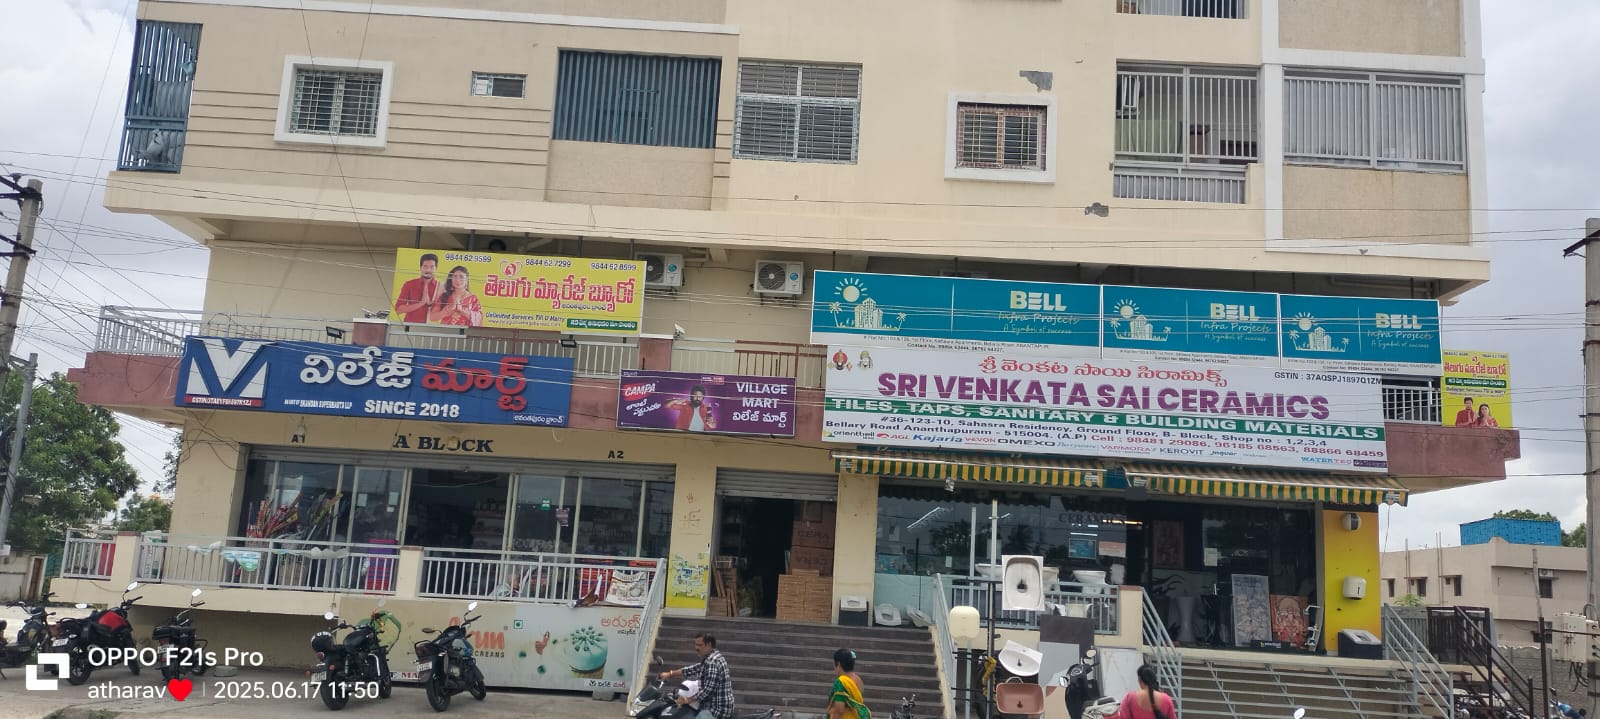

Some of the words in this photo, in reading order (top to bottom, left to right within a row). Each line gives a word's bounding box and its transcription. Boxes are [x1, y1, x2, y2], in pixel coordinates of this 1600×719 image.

[445, 253, 462, 261] 9844
[554, 260, 571, 268] 7299
[484, 274, 531, 299] తెలుగు
[534, 274, 587, 309] మ్యారేజ్
[588, 278, 636, 312] బ్యూరో
[1010, 290, 1067, 311] BELL
[998, 310, 1028, 324] Infra
[1033, 313, 1080, 326] Projects
[1210, 303, 1260, 321] BELL
[1200, 321, 1228, 332] Infra
[1230, 323, 1272, 334] Projects
[1375, 312, 1422, 330] BELL
[1367, 330, 1393, 340] Infra
[1395, 331, 1434, 341] Projects
[300, 345, 414, 389] విలేజ్
[422, 356, 528, 412] మార్ట్
[978, 356, 998, 374] శ్రీ
[1000, 359, 1068, 374] వెంకట
[1074, 362, 1132, 378] సాయి
[1137, 365, 1228, 388] సిరామిక్స్
[1274, 371, 1299, 380] GSTIN
[624, 385, 656, 398] CAMPA
[736, 382, 788, 395] VILLAGE
[878, 373, 927, 398] SRI
[933, 375, 1091, 407] VENKATA
[1097, 384, 1150, 410] SAI
[1157, 387, 1330, 420] CERAMICS
[419, 402, 460, 418] 2018
[742, 397, 780, 409] MART
[732, 409, 760, 422] విలేజ్
[762, 411, 788, 428] మార్ట్
[831, 398, 899, 414] TILES,
[906, 402, 971, 417] TAPS,
[979, 406, 1098, 422] SANITARY
[1104, 414, 1119, 424] &
[1125, 414, 1237, 431] BUILDING
[291, 434, 306, 444] A1
[825, 420, 866, 430] Bellary
[869, 423, 900, 431] Road
[903, 424, 992, 435] Ananthapuram
[1126, 436, 1164, 445] 98481
[1215, 442, 1253, 450] 96185
[1303, 447, 1342, 455] 88866
[833, 430, 875, 438] orientbell
[957, 419, 1006, 428] Sahasra
[1009, 422, 1073, 433] Residency,
[1076, 426, 1121, 435] Ground
[1125, 429, 1159, 438] Floor,
[1179, 432, 1218, 441] Block,
[1221, 434, 1253, 443] Shop
[1286, 438, 1328, 447] 1,2,3,4
[418, 436, 494, 453] BLOCK
[912, 433, 963, 443] Kajaria
[997, 438, 1056, 447] OMEXO
[1159, 447, 1204, 455] KEROVIT
[607, 450, 624, 459] A2
[601, 614, 641, 629] అరుణ్
